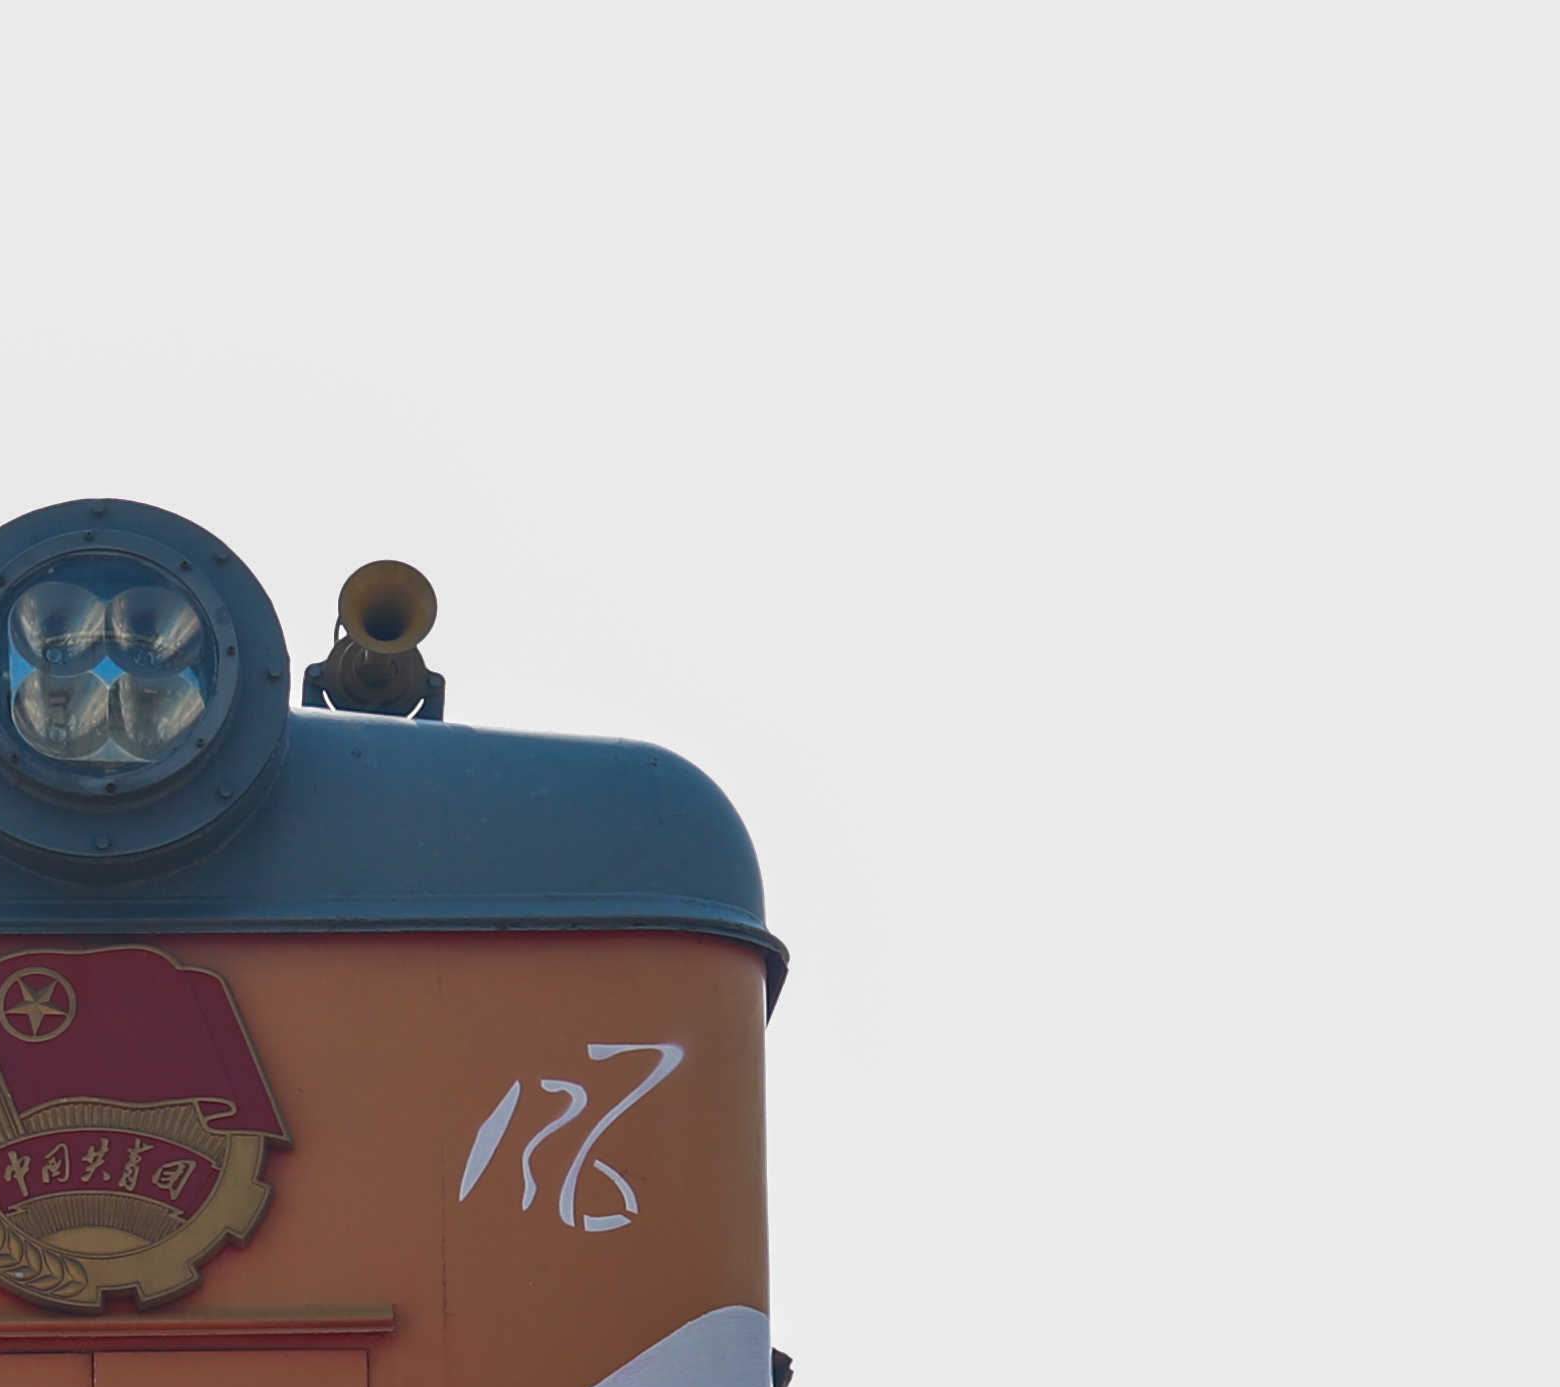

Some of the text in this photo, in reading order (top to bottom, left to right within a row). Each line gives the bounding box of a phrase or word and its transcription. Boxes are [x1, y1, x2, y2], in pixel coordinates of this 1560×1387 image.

[2, 1137, 198, 1200] 中国共青团
